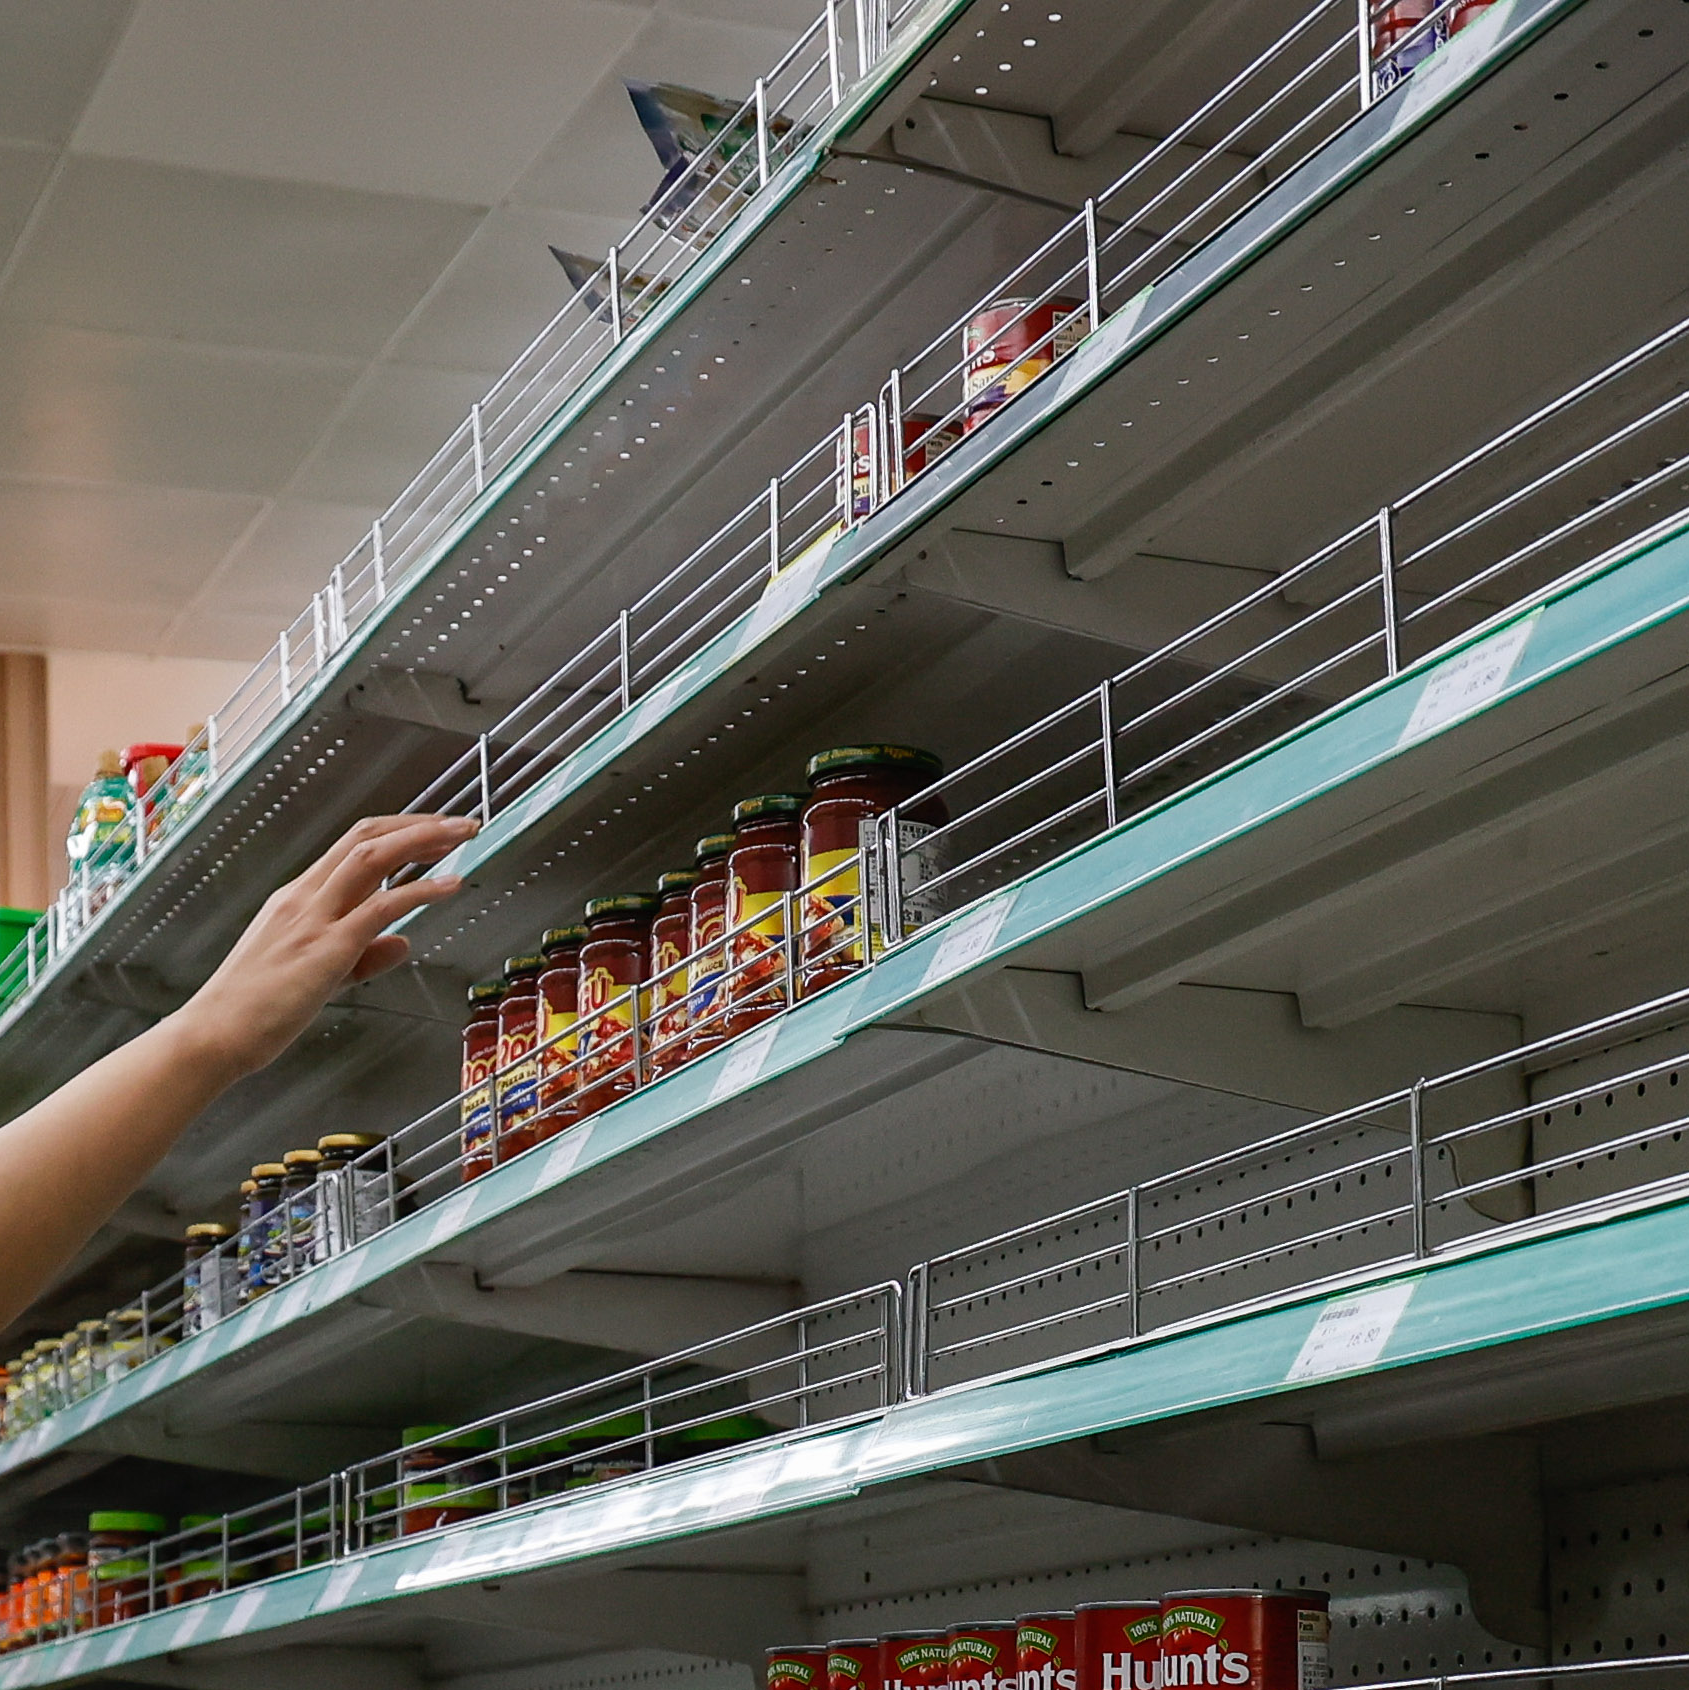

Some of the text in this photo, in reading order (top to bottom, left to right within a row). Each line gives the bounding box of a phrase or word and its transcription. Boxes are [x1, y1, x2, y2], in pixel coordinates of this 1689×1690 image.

[1130, 1620, 1158, 1638] 100%
[1175, 1611, 1217, 1630] NATURAL
[1020, 1631, 1052, 1649] NATURAL
[900, 1647, 949, 1666] 100% NATU
[957, 1641, 992, 1659] NATURAL
[776, 1662, 810, 1679] NATURAL
